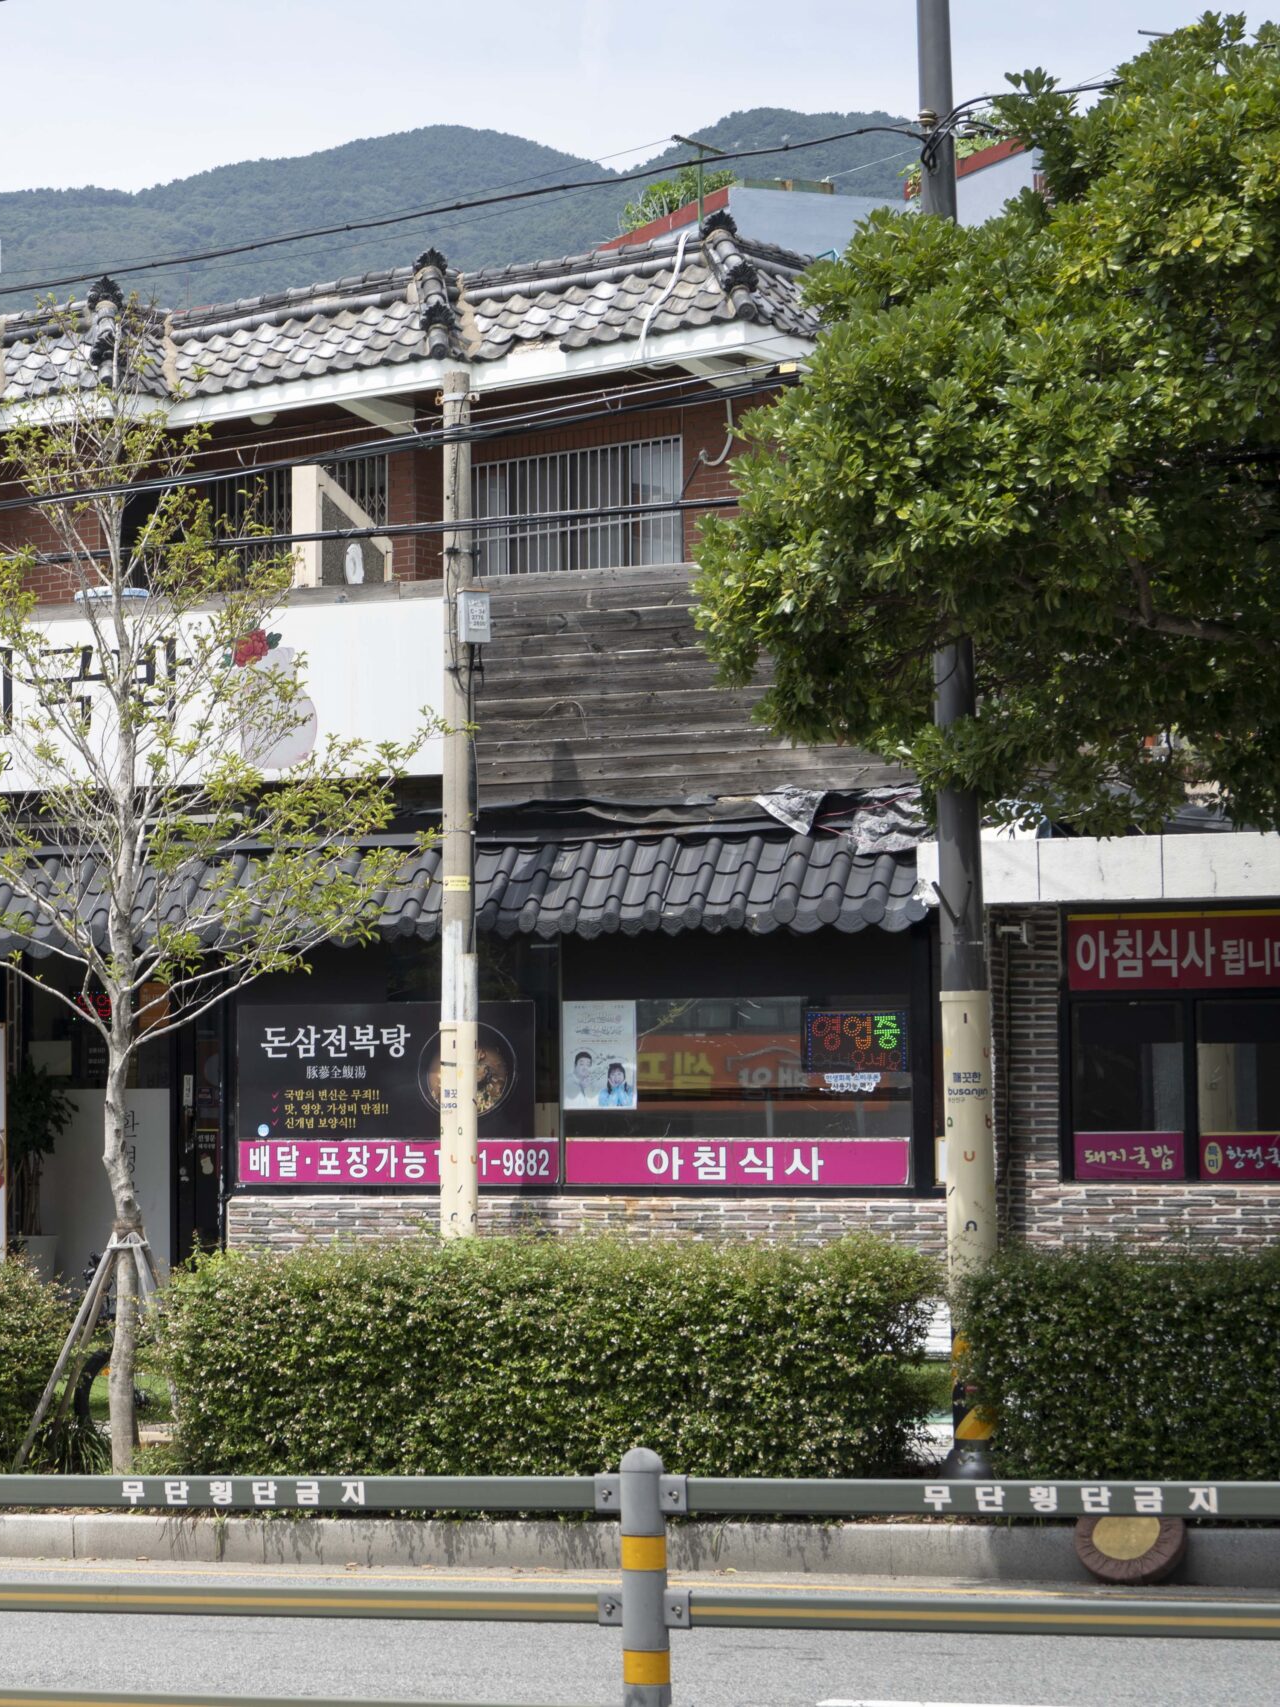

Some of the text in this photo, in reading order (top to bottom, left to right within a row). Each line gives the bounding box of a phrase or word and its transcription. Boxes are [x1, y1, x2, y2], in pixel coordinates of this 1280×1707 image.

[1075, 928, 1216, 979] 아침식사
[260, 1023, 412, 1059] 돈삼전복탕
[811, 1015, 901, 1051] 영업중
[952, 1071, 982, 1084] 깨끗한
[284, 1089, 315, 1101] 국밥의
[947, 1086, 988, 1098] busanjin
[284, 1117, 315, 1129] 신개념
[478, 1149, 550, 1177] 1-9882
[646, 1146, 825, 1181] 아침식사
[1084, 1144, 1175, 1171] 돼지국밥
[121, 1480, 366, 1506] 무단횡단금지
[923, 1486, 1220, 1514] 무단횡단금지
